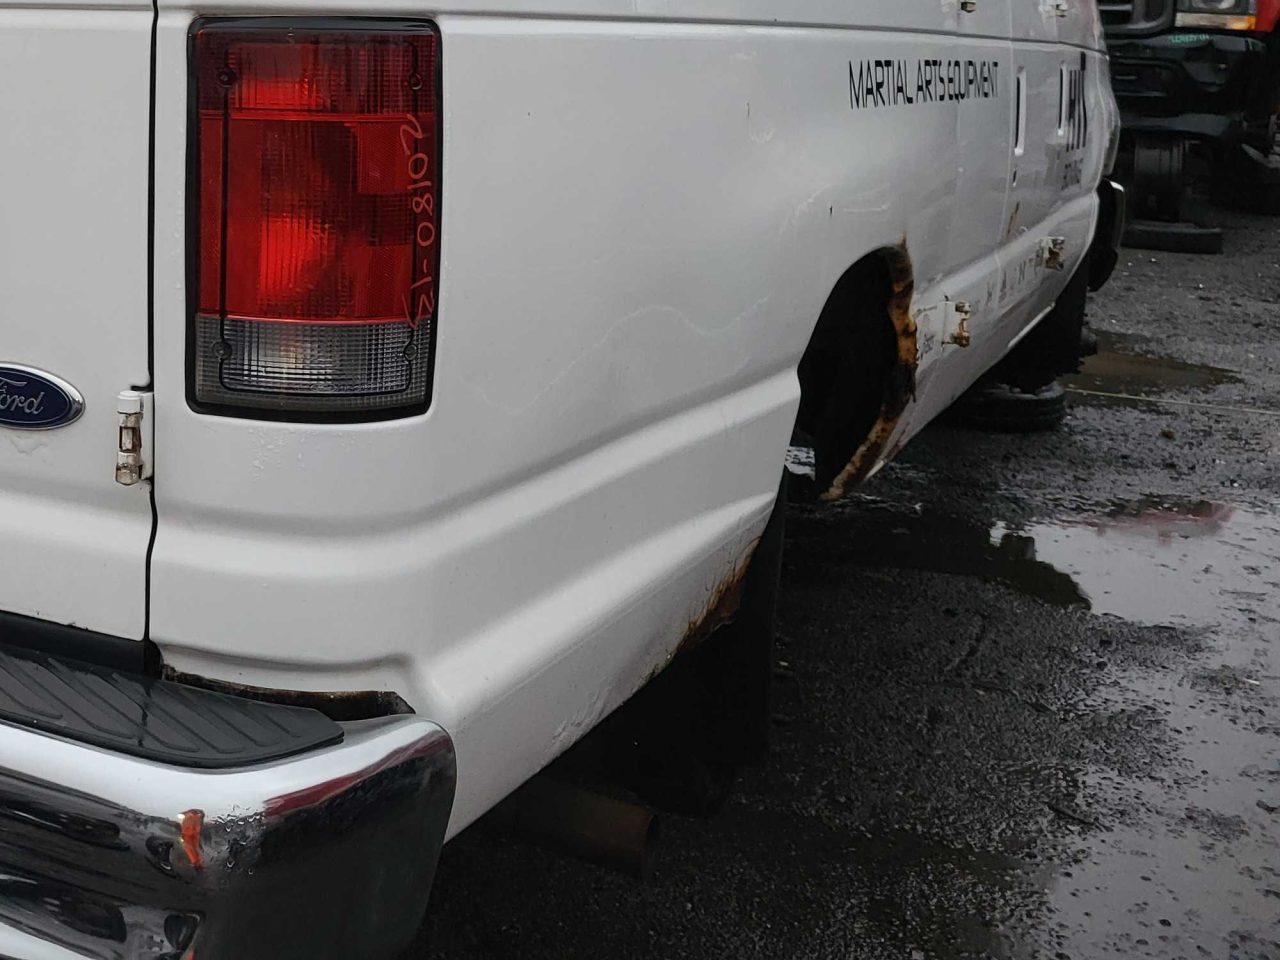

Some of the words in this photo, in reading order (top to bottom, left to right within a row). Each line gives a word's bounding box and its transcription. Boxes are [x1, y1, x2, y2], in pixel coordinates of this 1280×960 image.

[849, 59, 914, 109] MARTIAL
[916, 59, 946, 103] ARTS
[947, 60, 999, 104] EQUIPMENT
